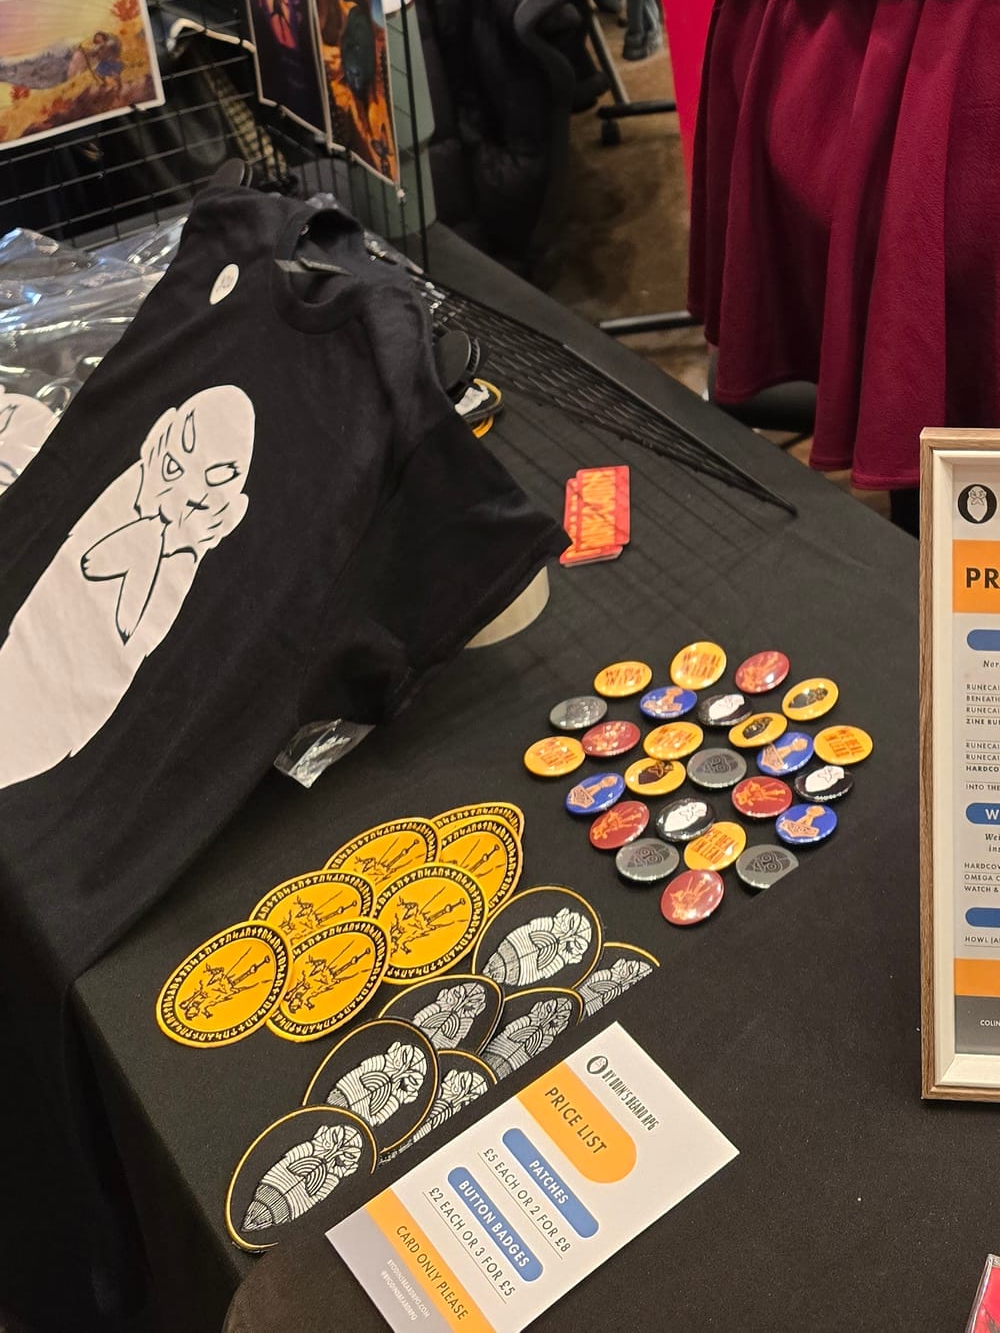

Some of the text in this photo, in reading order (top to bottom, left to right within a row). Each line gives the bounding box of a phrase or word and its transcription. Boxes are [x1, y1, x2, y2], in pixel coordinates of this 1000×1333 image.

[545, 1087, 607, 1153] PRICE LIST
[459, 1180, 530, 1267] BUTTON BADGES
[483, 1149, 571, 1252] £5 EACH OR 2 FOR £8
[529, 1160, 568, 1204] PATCHES
[397, 1226, 468, 1320] CARD ONLY PLEASE
[429, 1188, 515, 1296] £2 EACH OR 3 FOR £5
